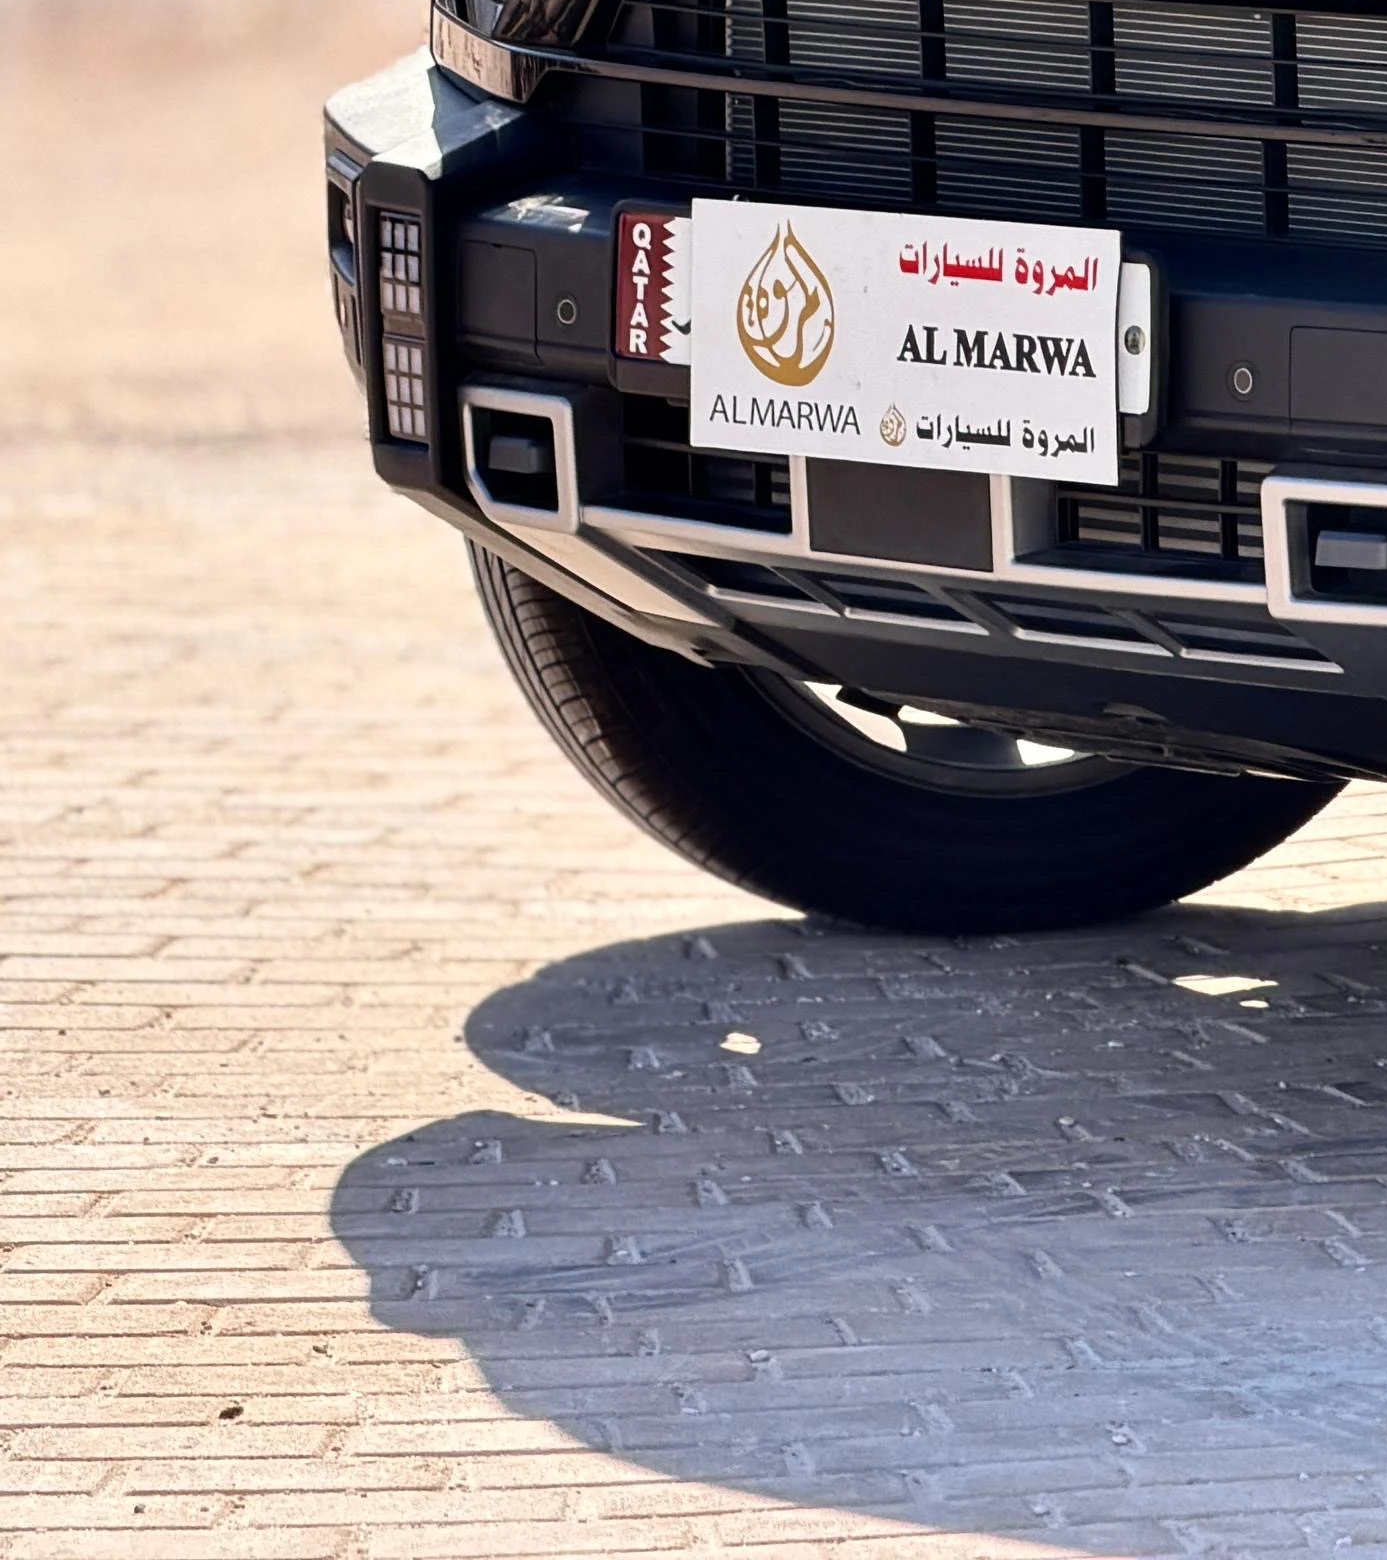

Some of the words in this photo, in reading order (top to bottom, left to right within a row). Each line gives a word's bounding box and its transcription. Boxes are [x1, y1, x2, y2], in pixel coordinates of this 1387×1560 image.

[899, 241, 1003, 287] للسيارات
[1014, 247, 1099, 296] المروة
[629, 222, 652, 354] QATAR
[896, 324, 947, 365] AL
[952, 328, 1097, 378] MARWA
[916, 414, 1011, 451] للسيارات
[1021, 419, 1095, 458] المروة
